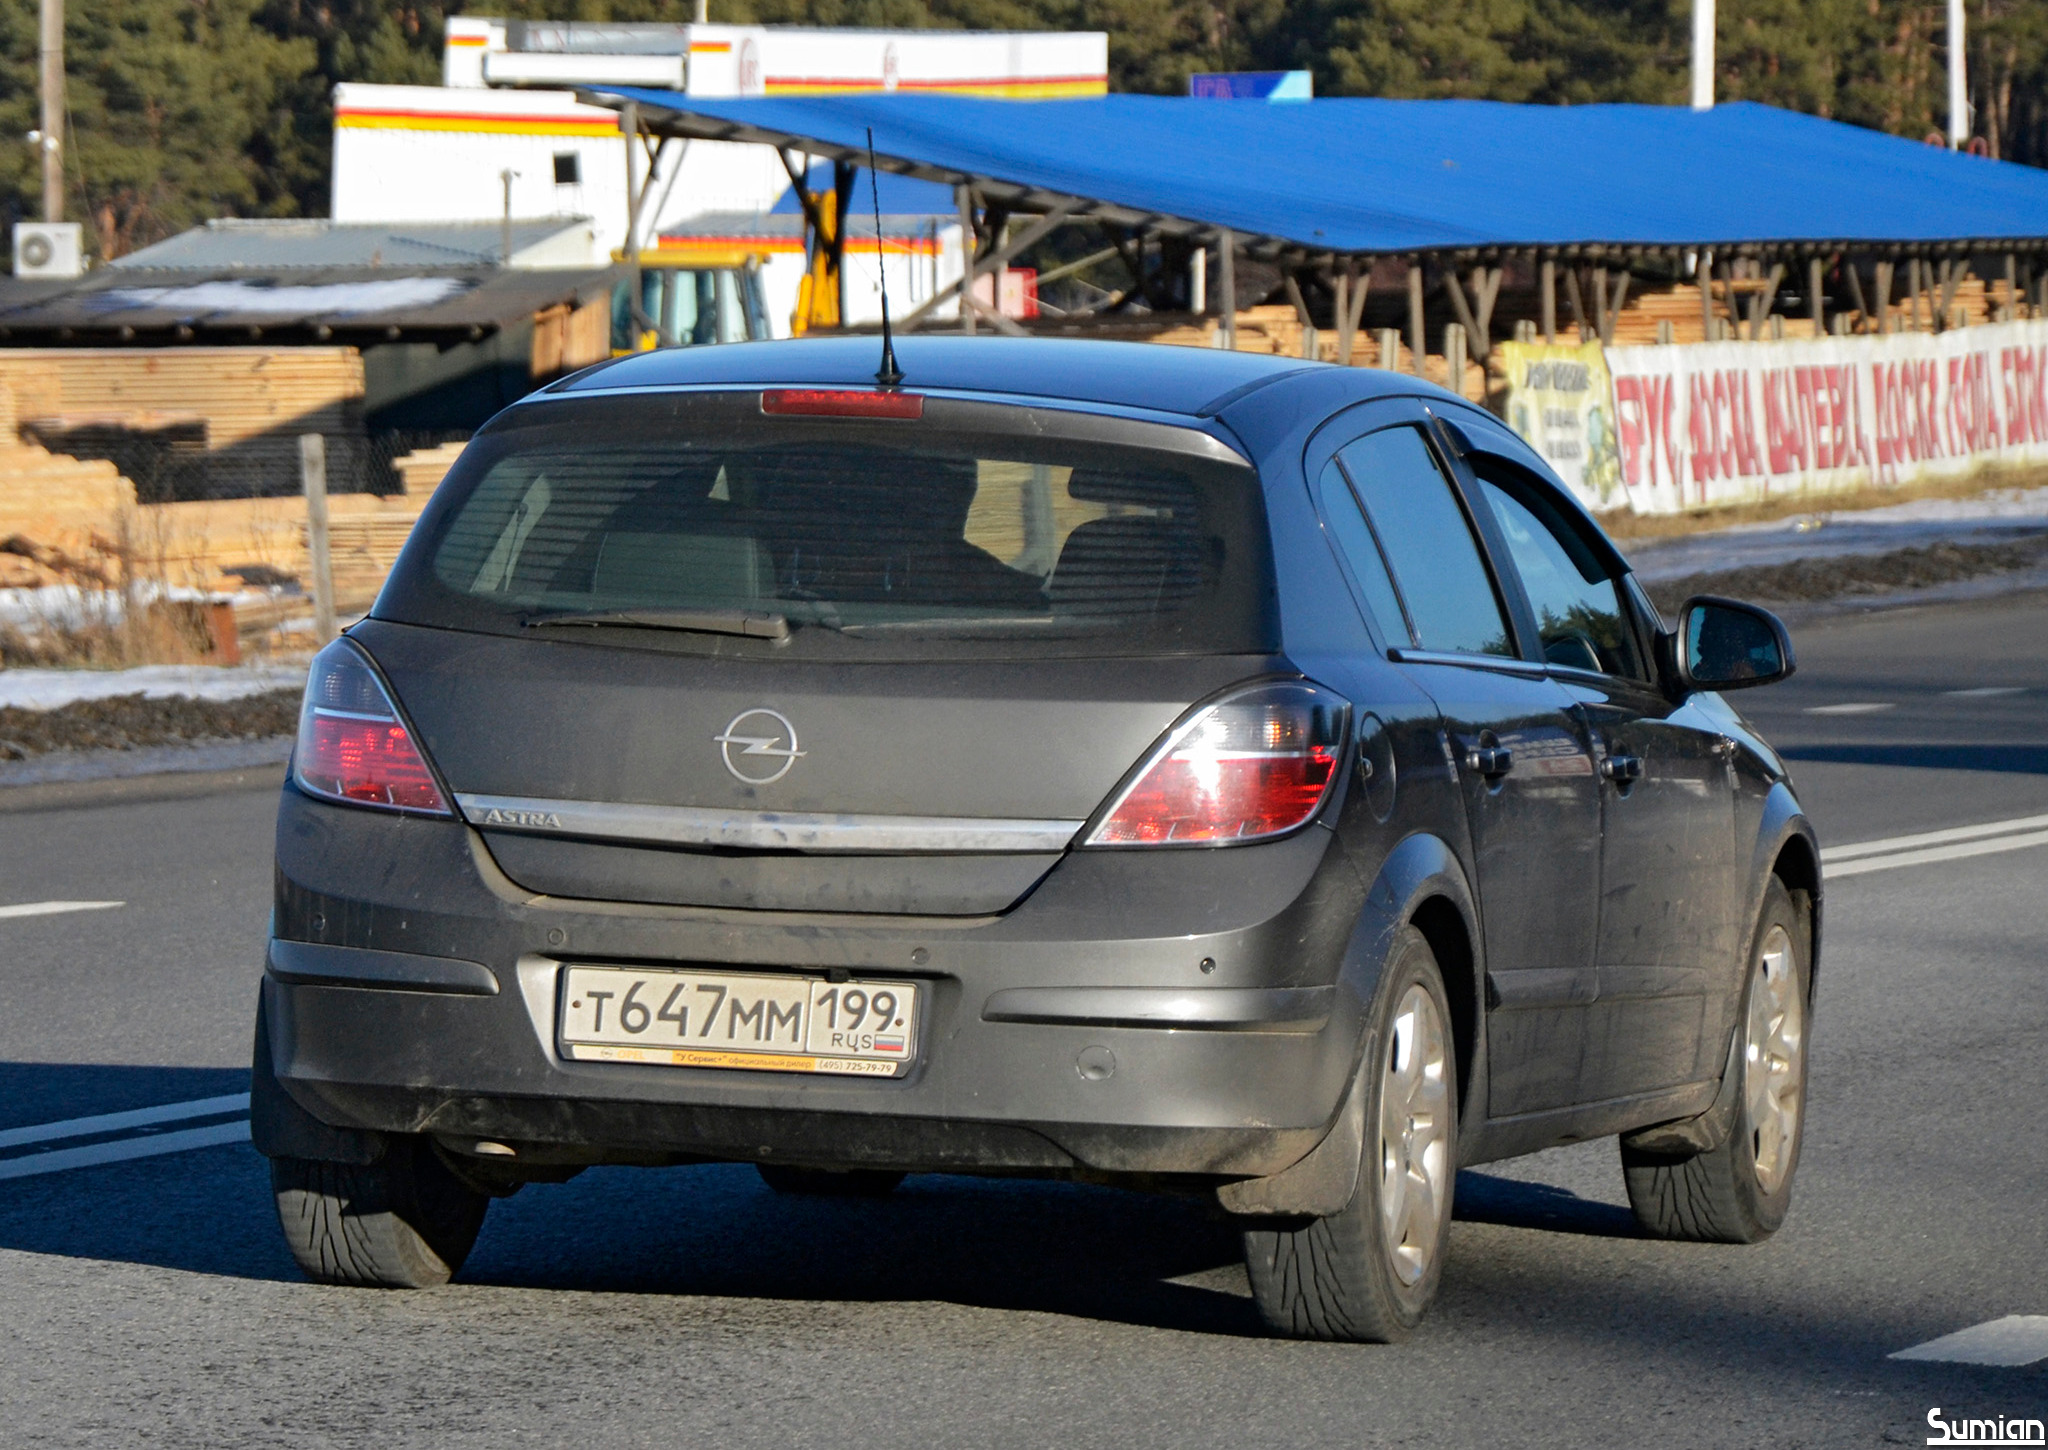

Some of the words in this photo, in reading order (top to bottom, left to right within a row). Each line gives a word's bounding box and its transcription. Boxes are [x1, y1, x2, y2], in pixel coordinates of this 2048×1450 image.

[484, 808, 561, 828] ASTRA
[817, 987, 900, 1032] 199
[831, 1032, 873, 1050] RUS
[785, 1059, 812, 1070] дилер
[819, 1060, 843, 1070] (495)
[845, 1061, 892, 1073] 725-79-79
